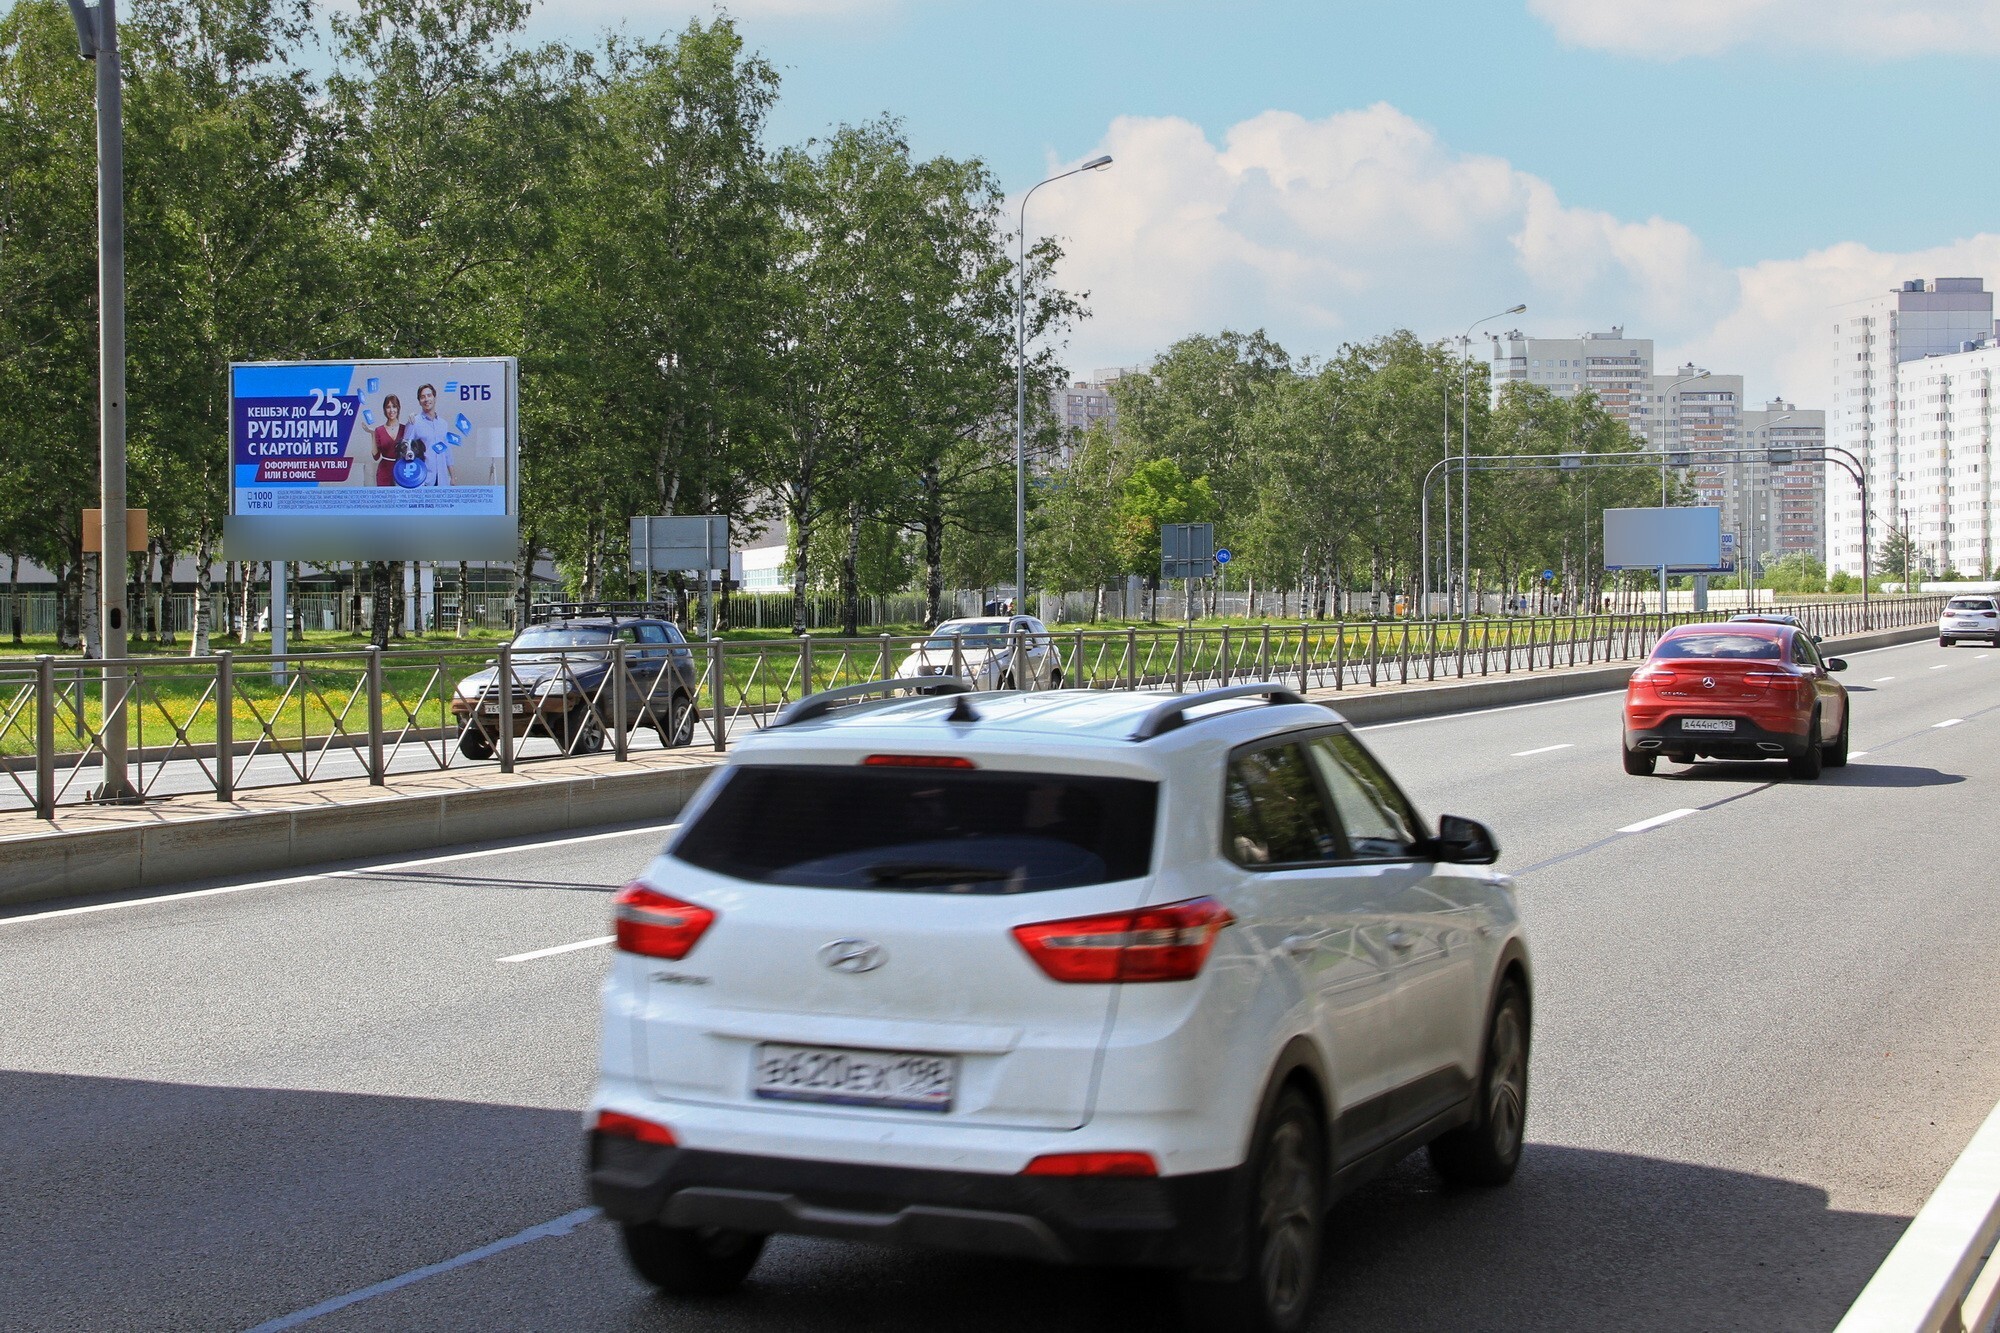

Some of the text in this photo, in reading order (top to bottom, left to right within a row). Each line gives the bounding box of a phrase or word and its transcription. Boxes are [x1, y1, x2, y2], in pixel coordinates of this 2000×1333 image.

[460, 384, 491, 401] ВТБ
[247, 388, 354, 419] КЕШБЭК ДО 25%
[247, 419, 338, 439] РУБЛЯМИ
[248, 439, 339, 456] С КАРТОЙ ВТБ
[264, 460, 348, 470] ОФОРМИТЕ НА VTB.RU
[264, 471, 316, 479] ИЛИ В ОФИСЕ
[253, 491, 273, 500] 1000
[248, 501, 273, 509] VTB.RU
